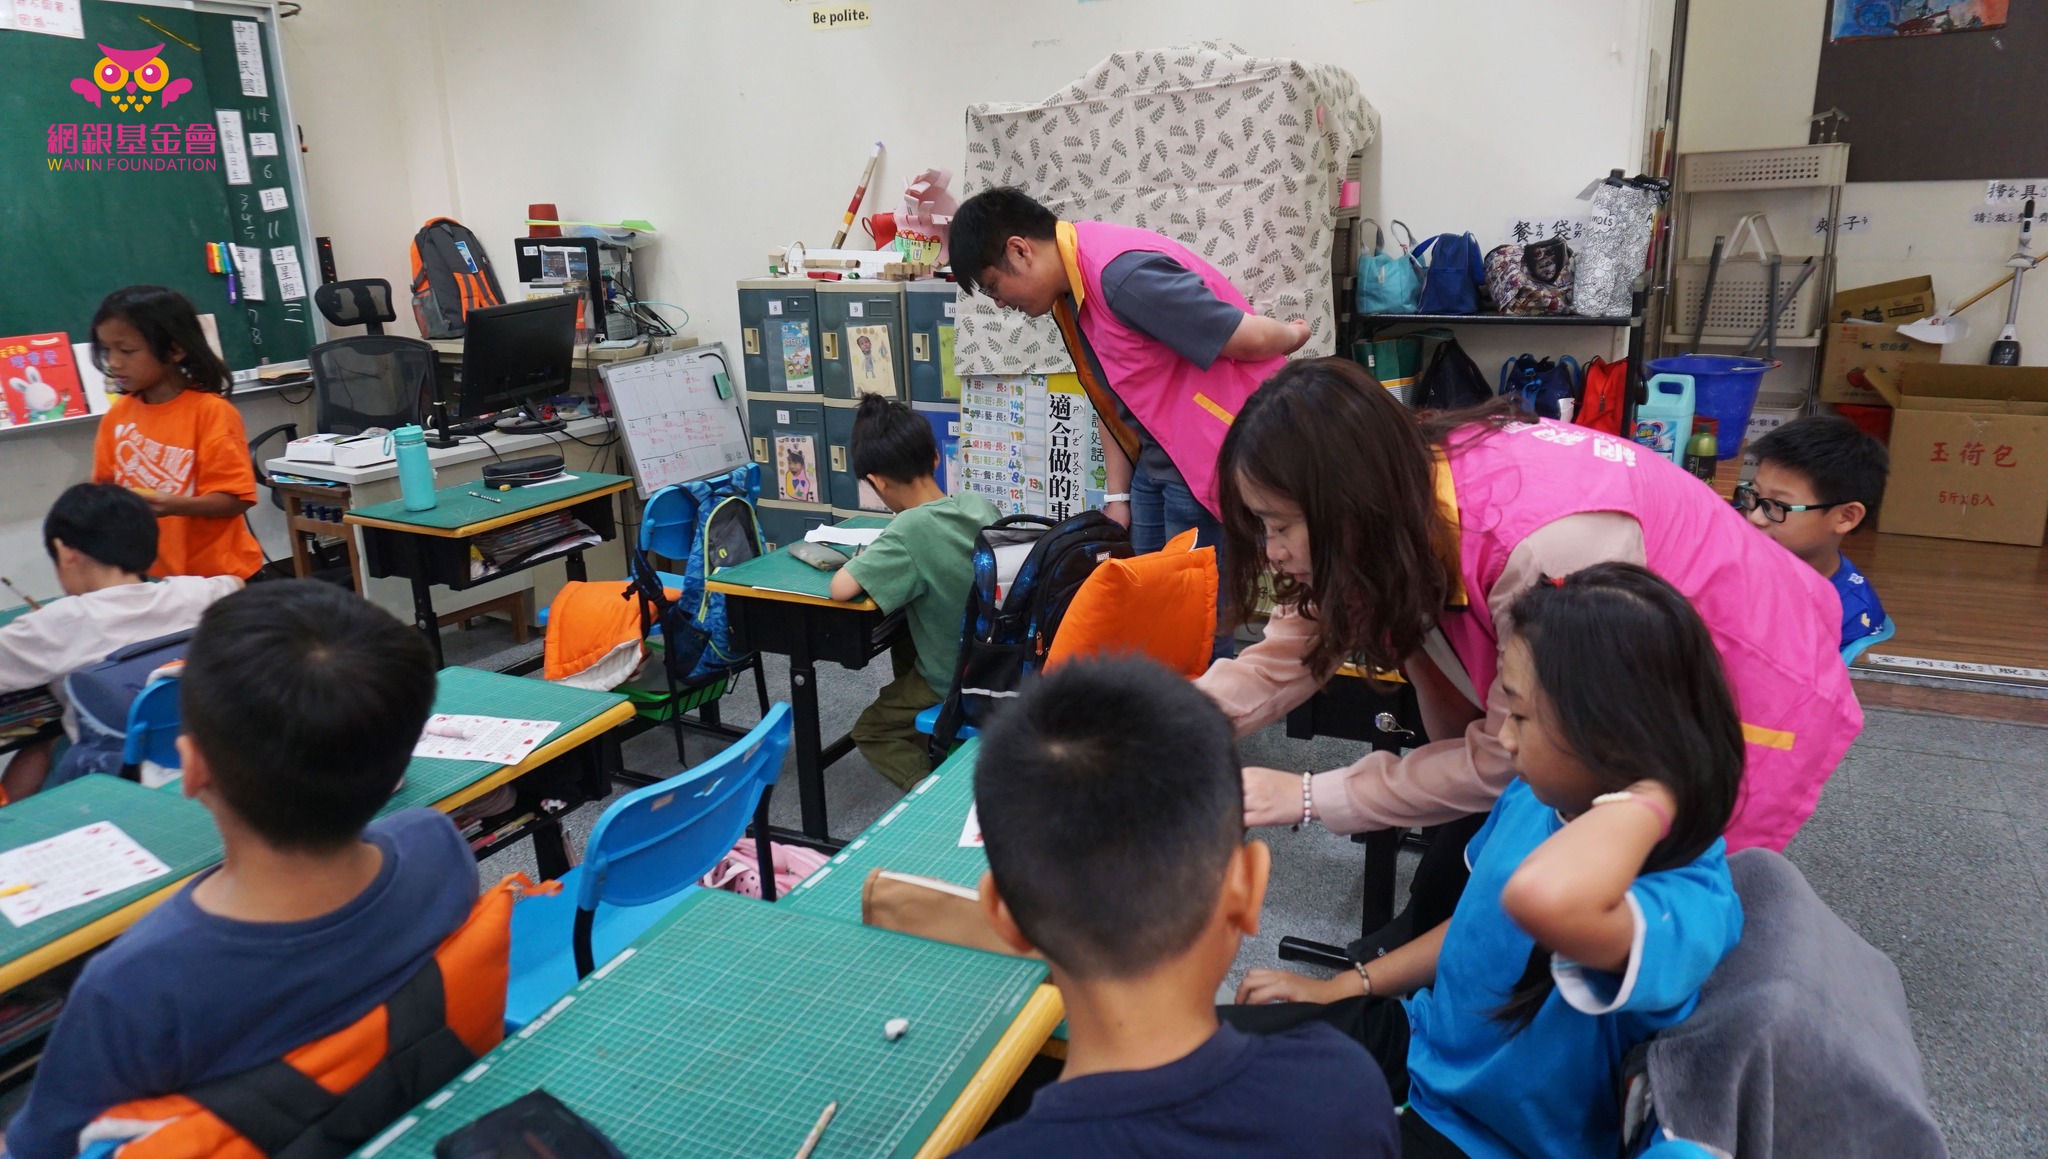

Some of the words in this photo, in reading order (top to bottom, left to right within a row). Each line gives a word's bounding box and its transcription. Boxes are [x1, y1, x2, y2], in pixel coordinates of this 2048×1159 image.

[813, 12, 826, 24] Be
[829, 9, 869, 25] polite.
[264, 164, 273, 179] 6
[773, 304, 779, 312] 8
[780, 413, 787, 421] 11
[1011, 445, 1017, 457] 5
[1930, 442, 2017, 468] 玉荷包
[1049, 394, 1072, 521] 適合做的事
[1008, 459, 1017, 471] 4
[1011, 471, 1020, 484] 8
[1029, 478, 1039, 490] 13
[1010, 489, 1020, 500] 12
